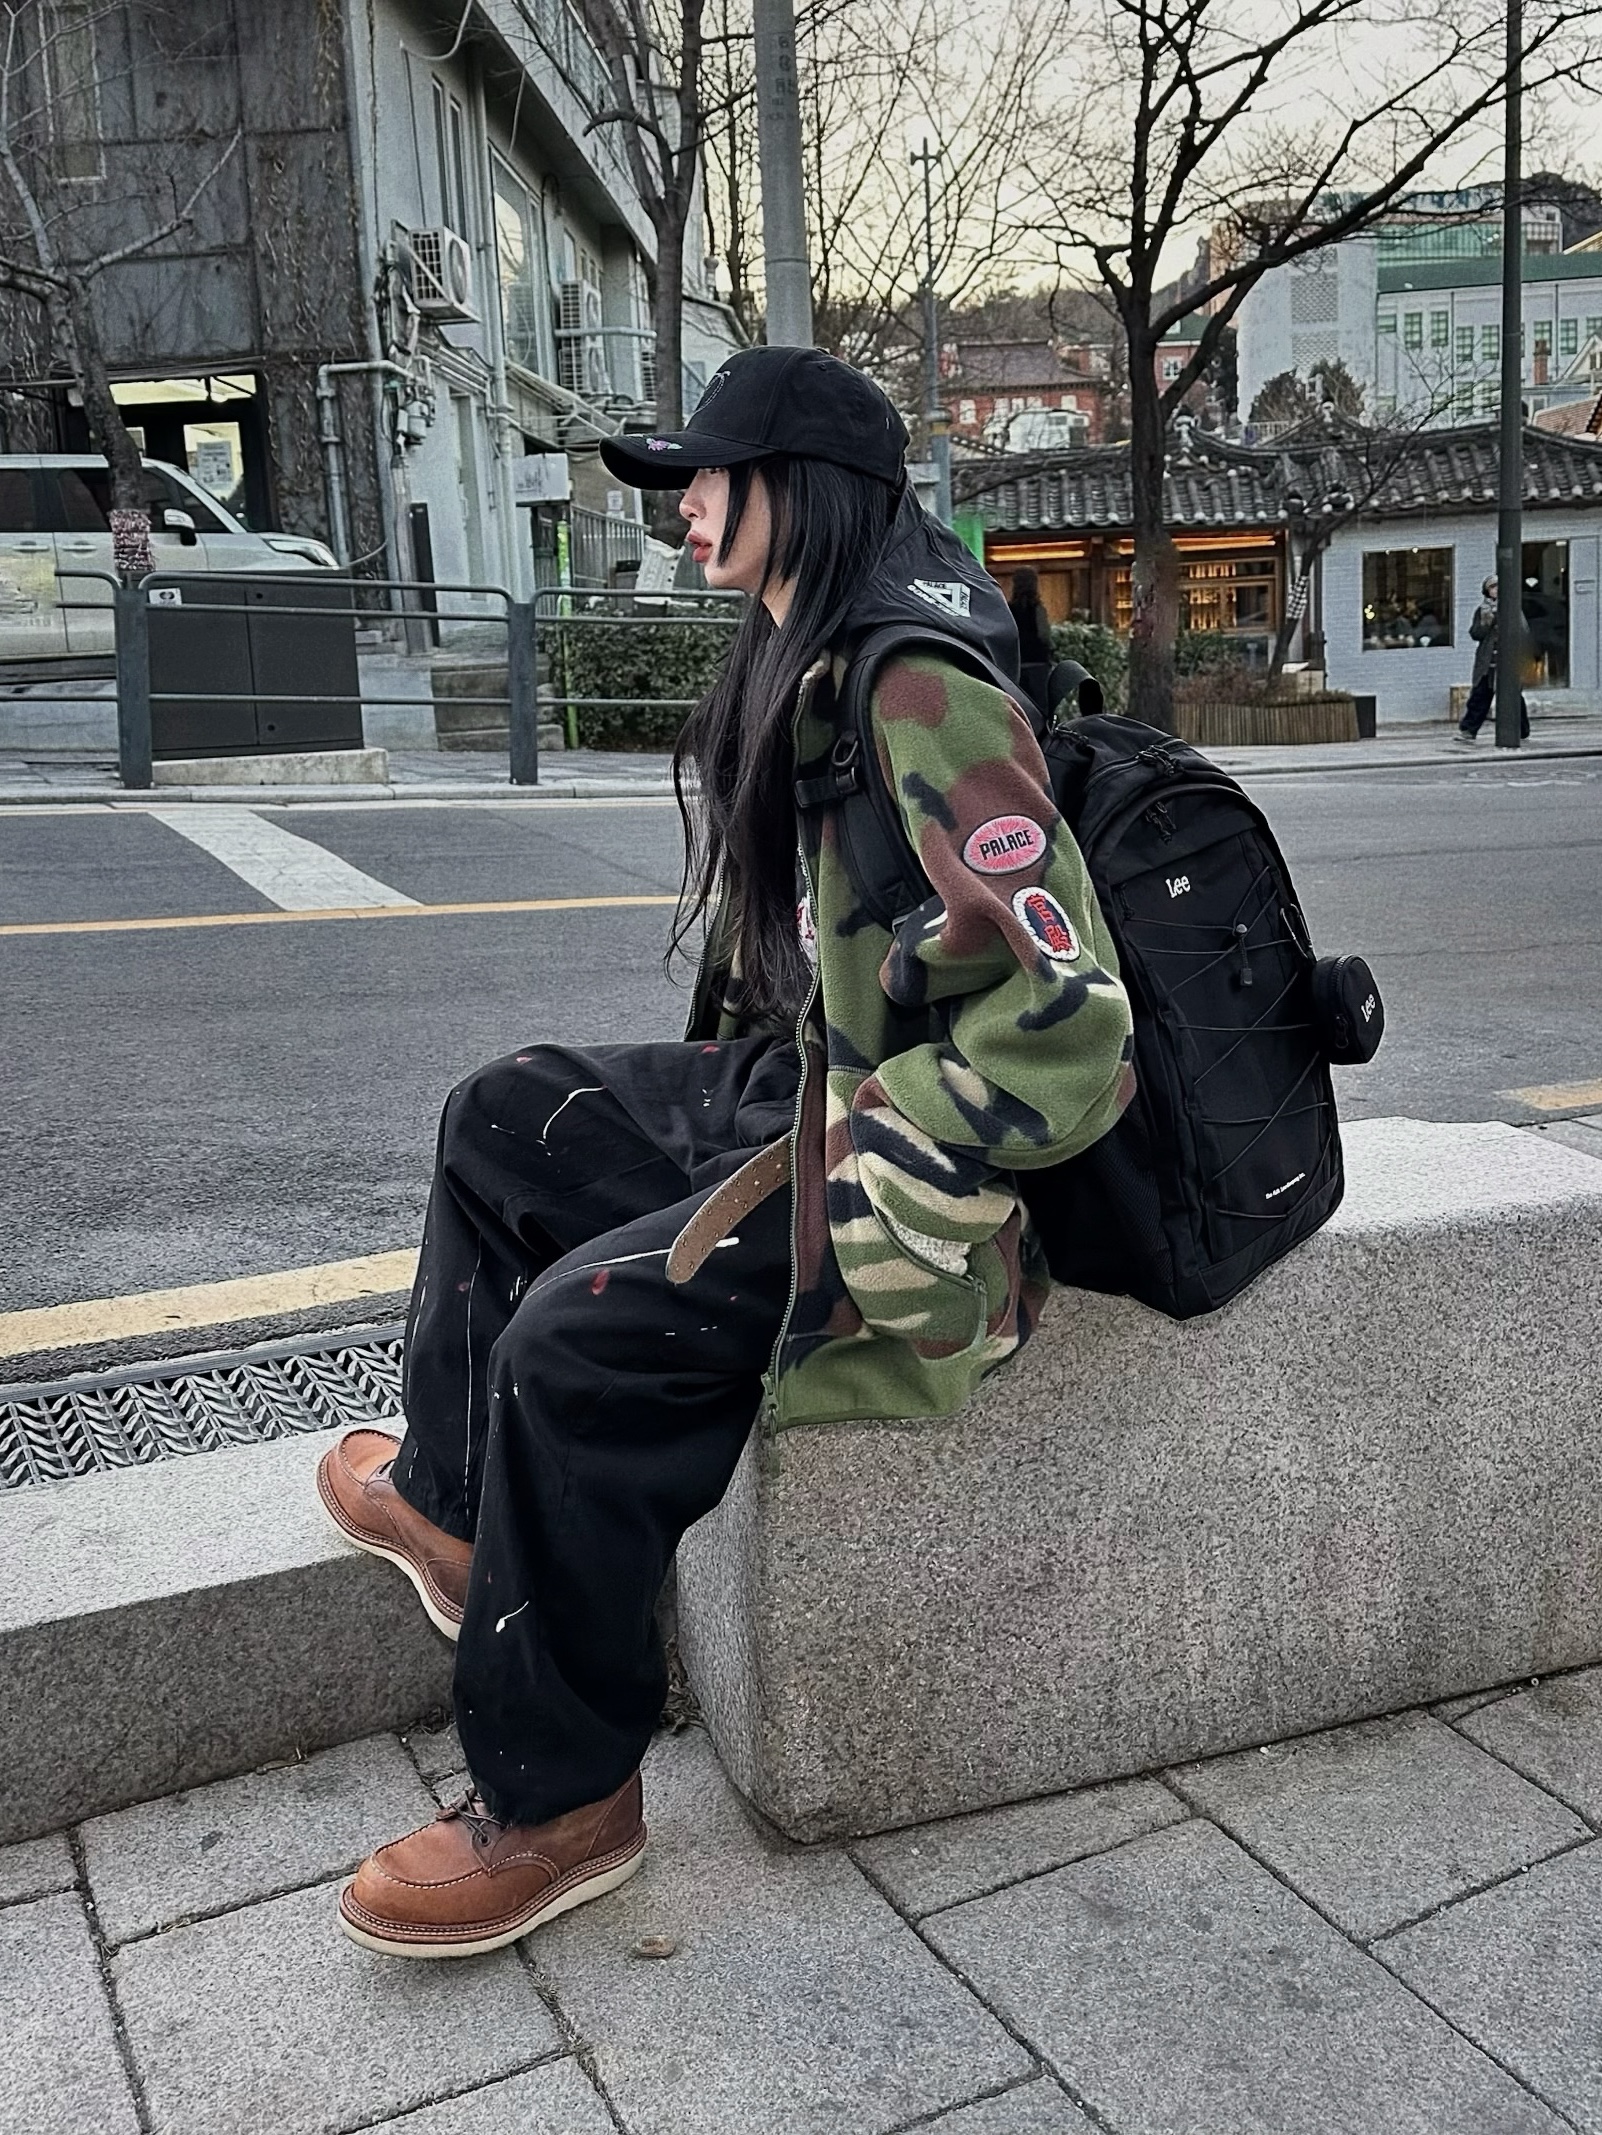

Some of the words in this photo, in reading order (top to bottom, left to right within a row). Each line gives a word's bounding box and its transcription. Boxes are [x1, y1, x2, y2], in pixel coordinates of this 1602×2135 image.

[979, 829, 1034, 860] PALACE
[1165, 875, 1191, 898] Lee
[1361, 994, 1376, 1022] Lee
